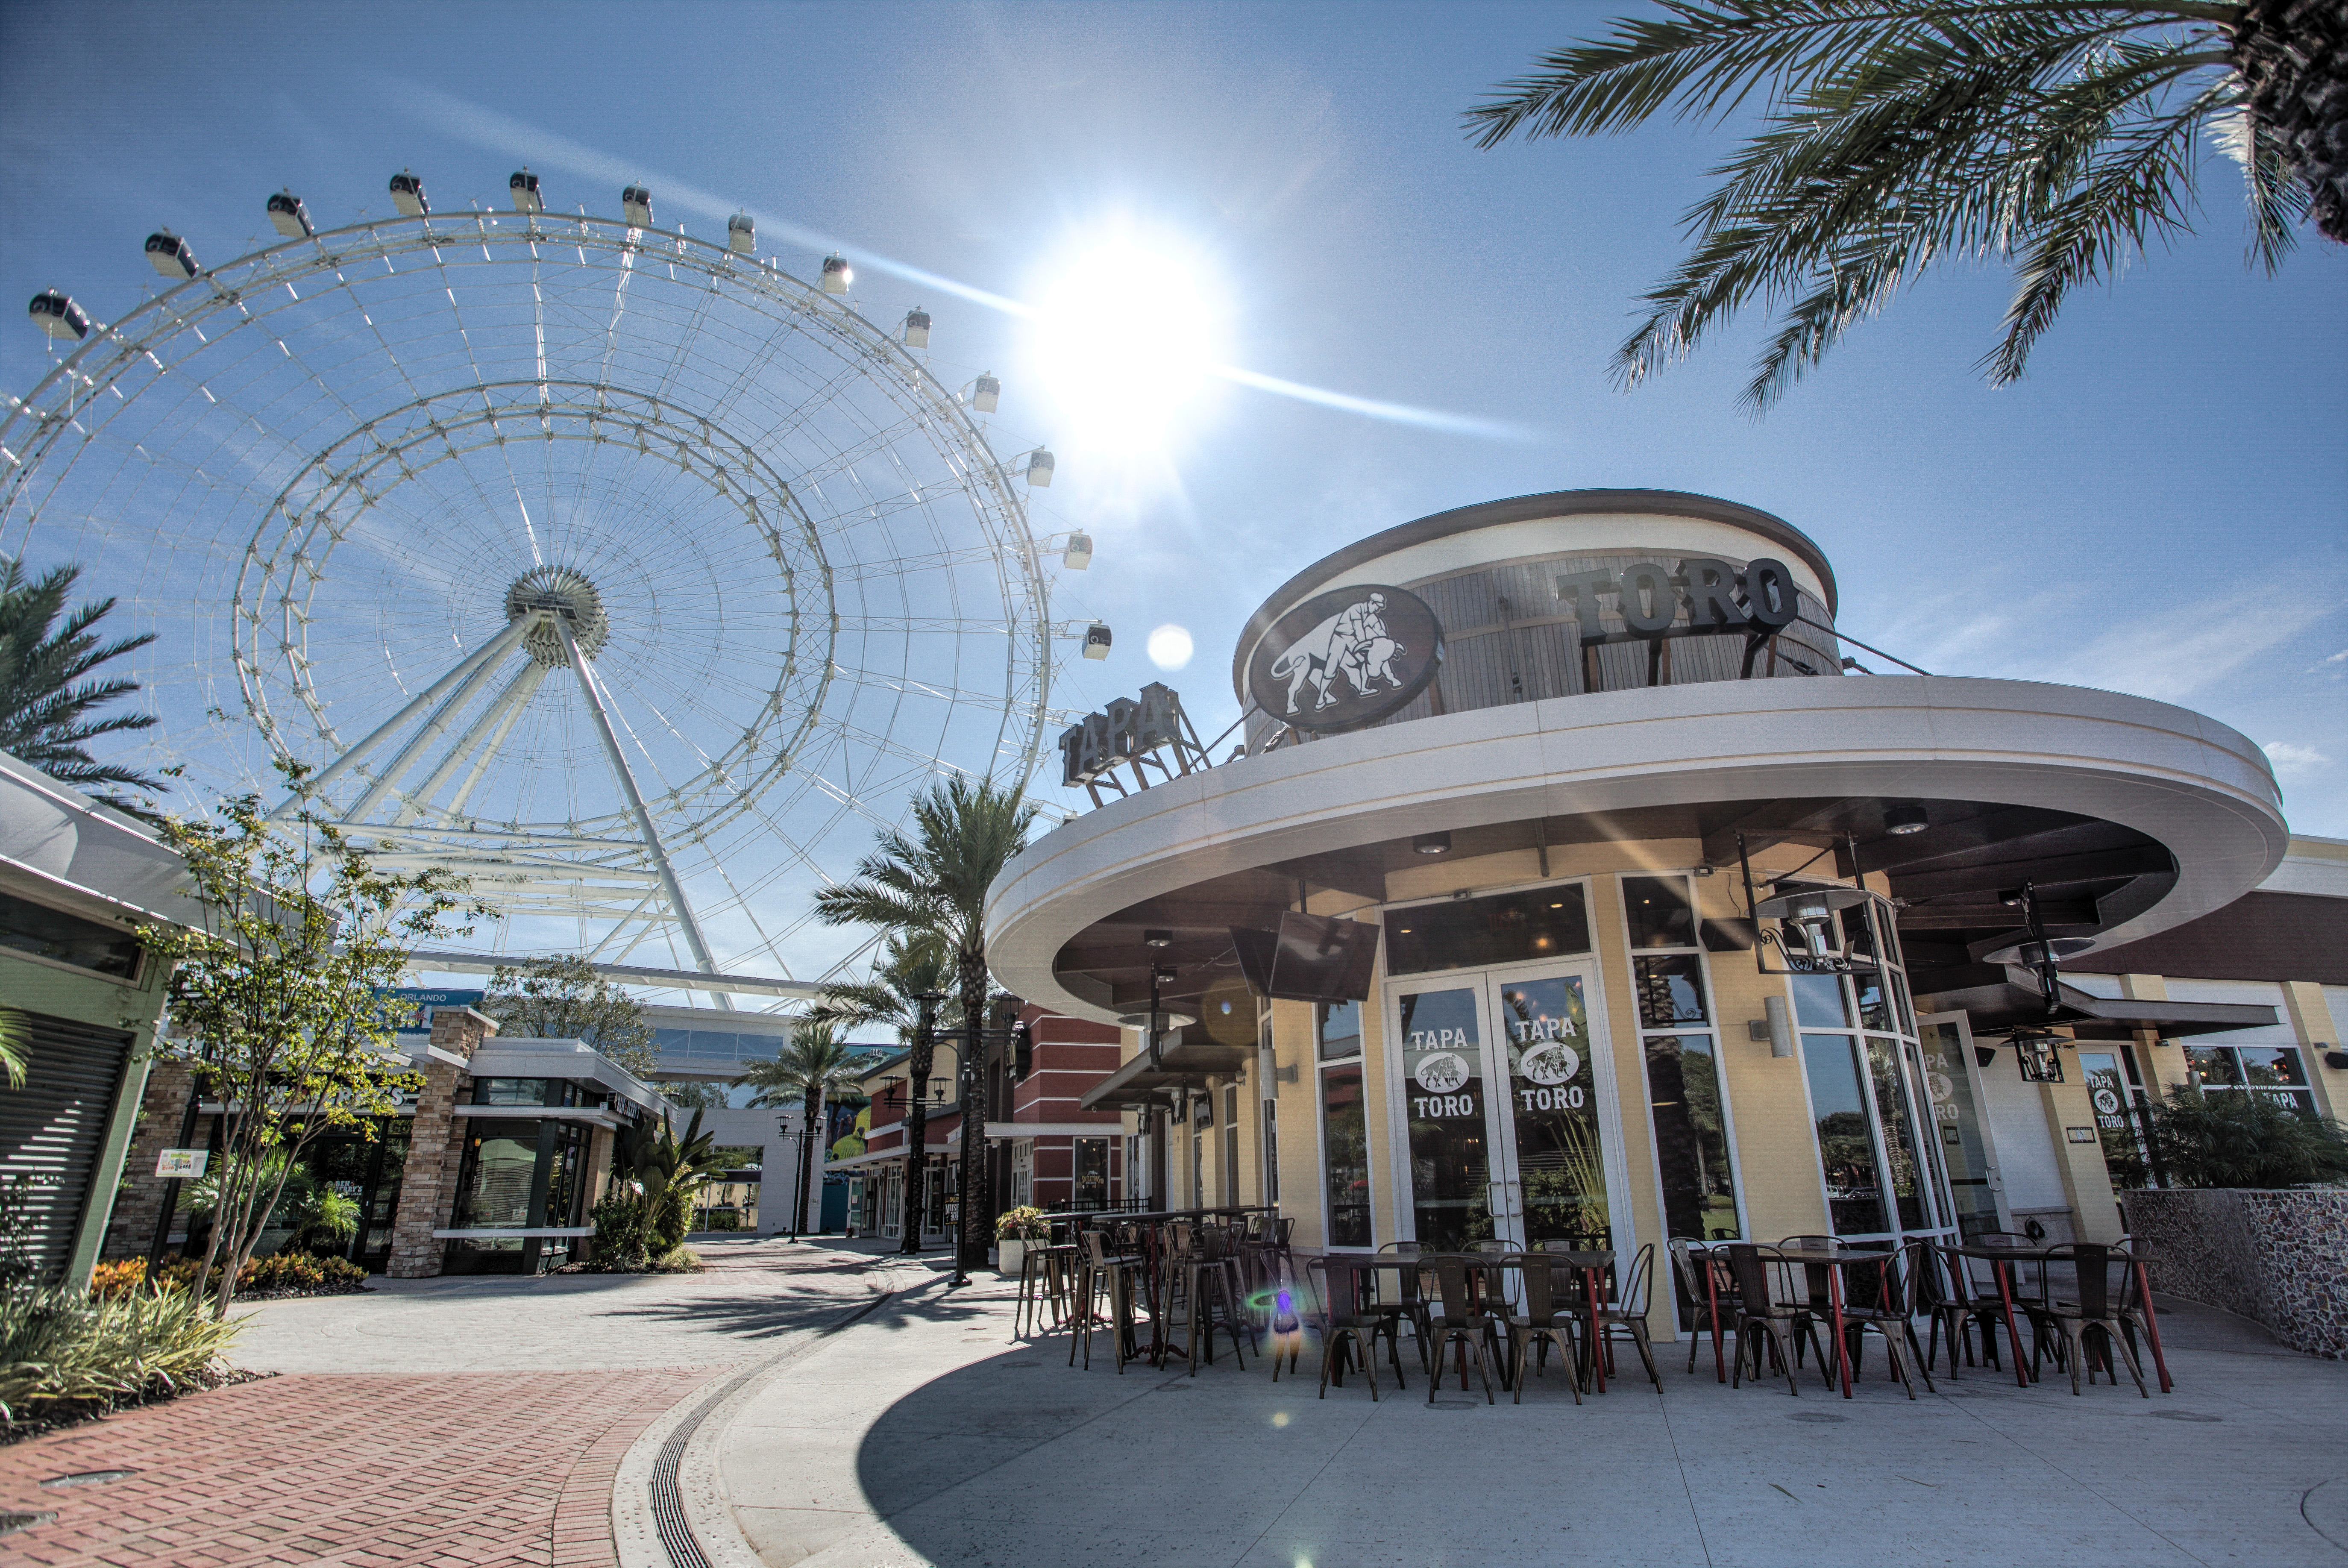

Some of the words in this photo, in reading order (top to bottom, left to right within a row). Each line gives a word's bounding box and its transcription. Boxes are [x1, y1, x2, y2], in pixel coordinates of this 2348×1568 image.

[1556, 558, 1802, 644] TORO
[1059, 681, 1180, 788] TAPA
[400, 993, 446, 1002] ORLANDO
[1411, 1027, 1468, 1051] TAPA
[1515, 1017, 1577, 1041] TAPA
[1924, 1053, 1949, 1069] PA
[2088, 1075, 2114, 1088] TAPA
[1414, 1094, 1473, 1118] TORO
[1520, 1086, 1585, 1111] TORO
[1934, 1104, 1959, 1120] RO
[2097, 1115, 2124, 1128] TORO
[945, 1203, 959, 1215] MUSE
